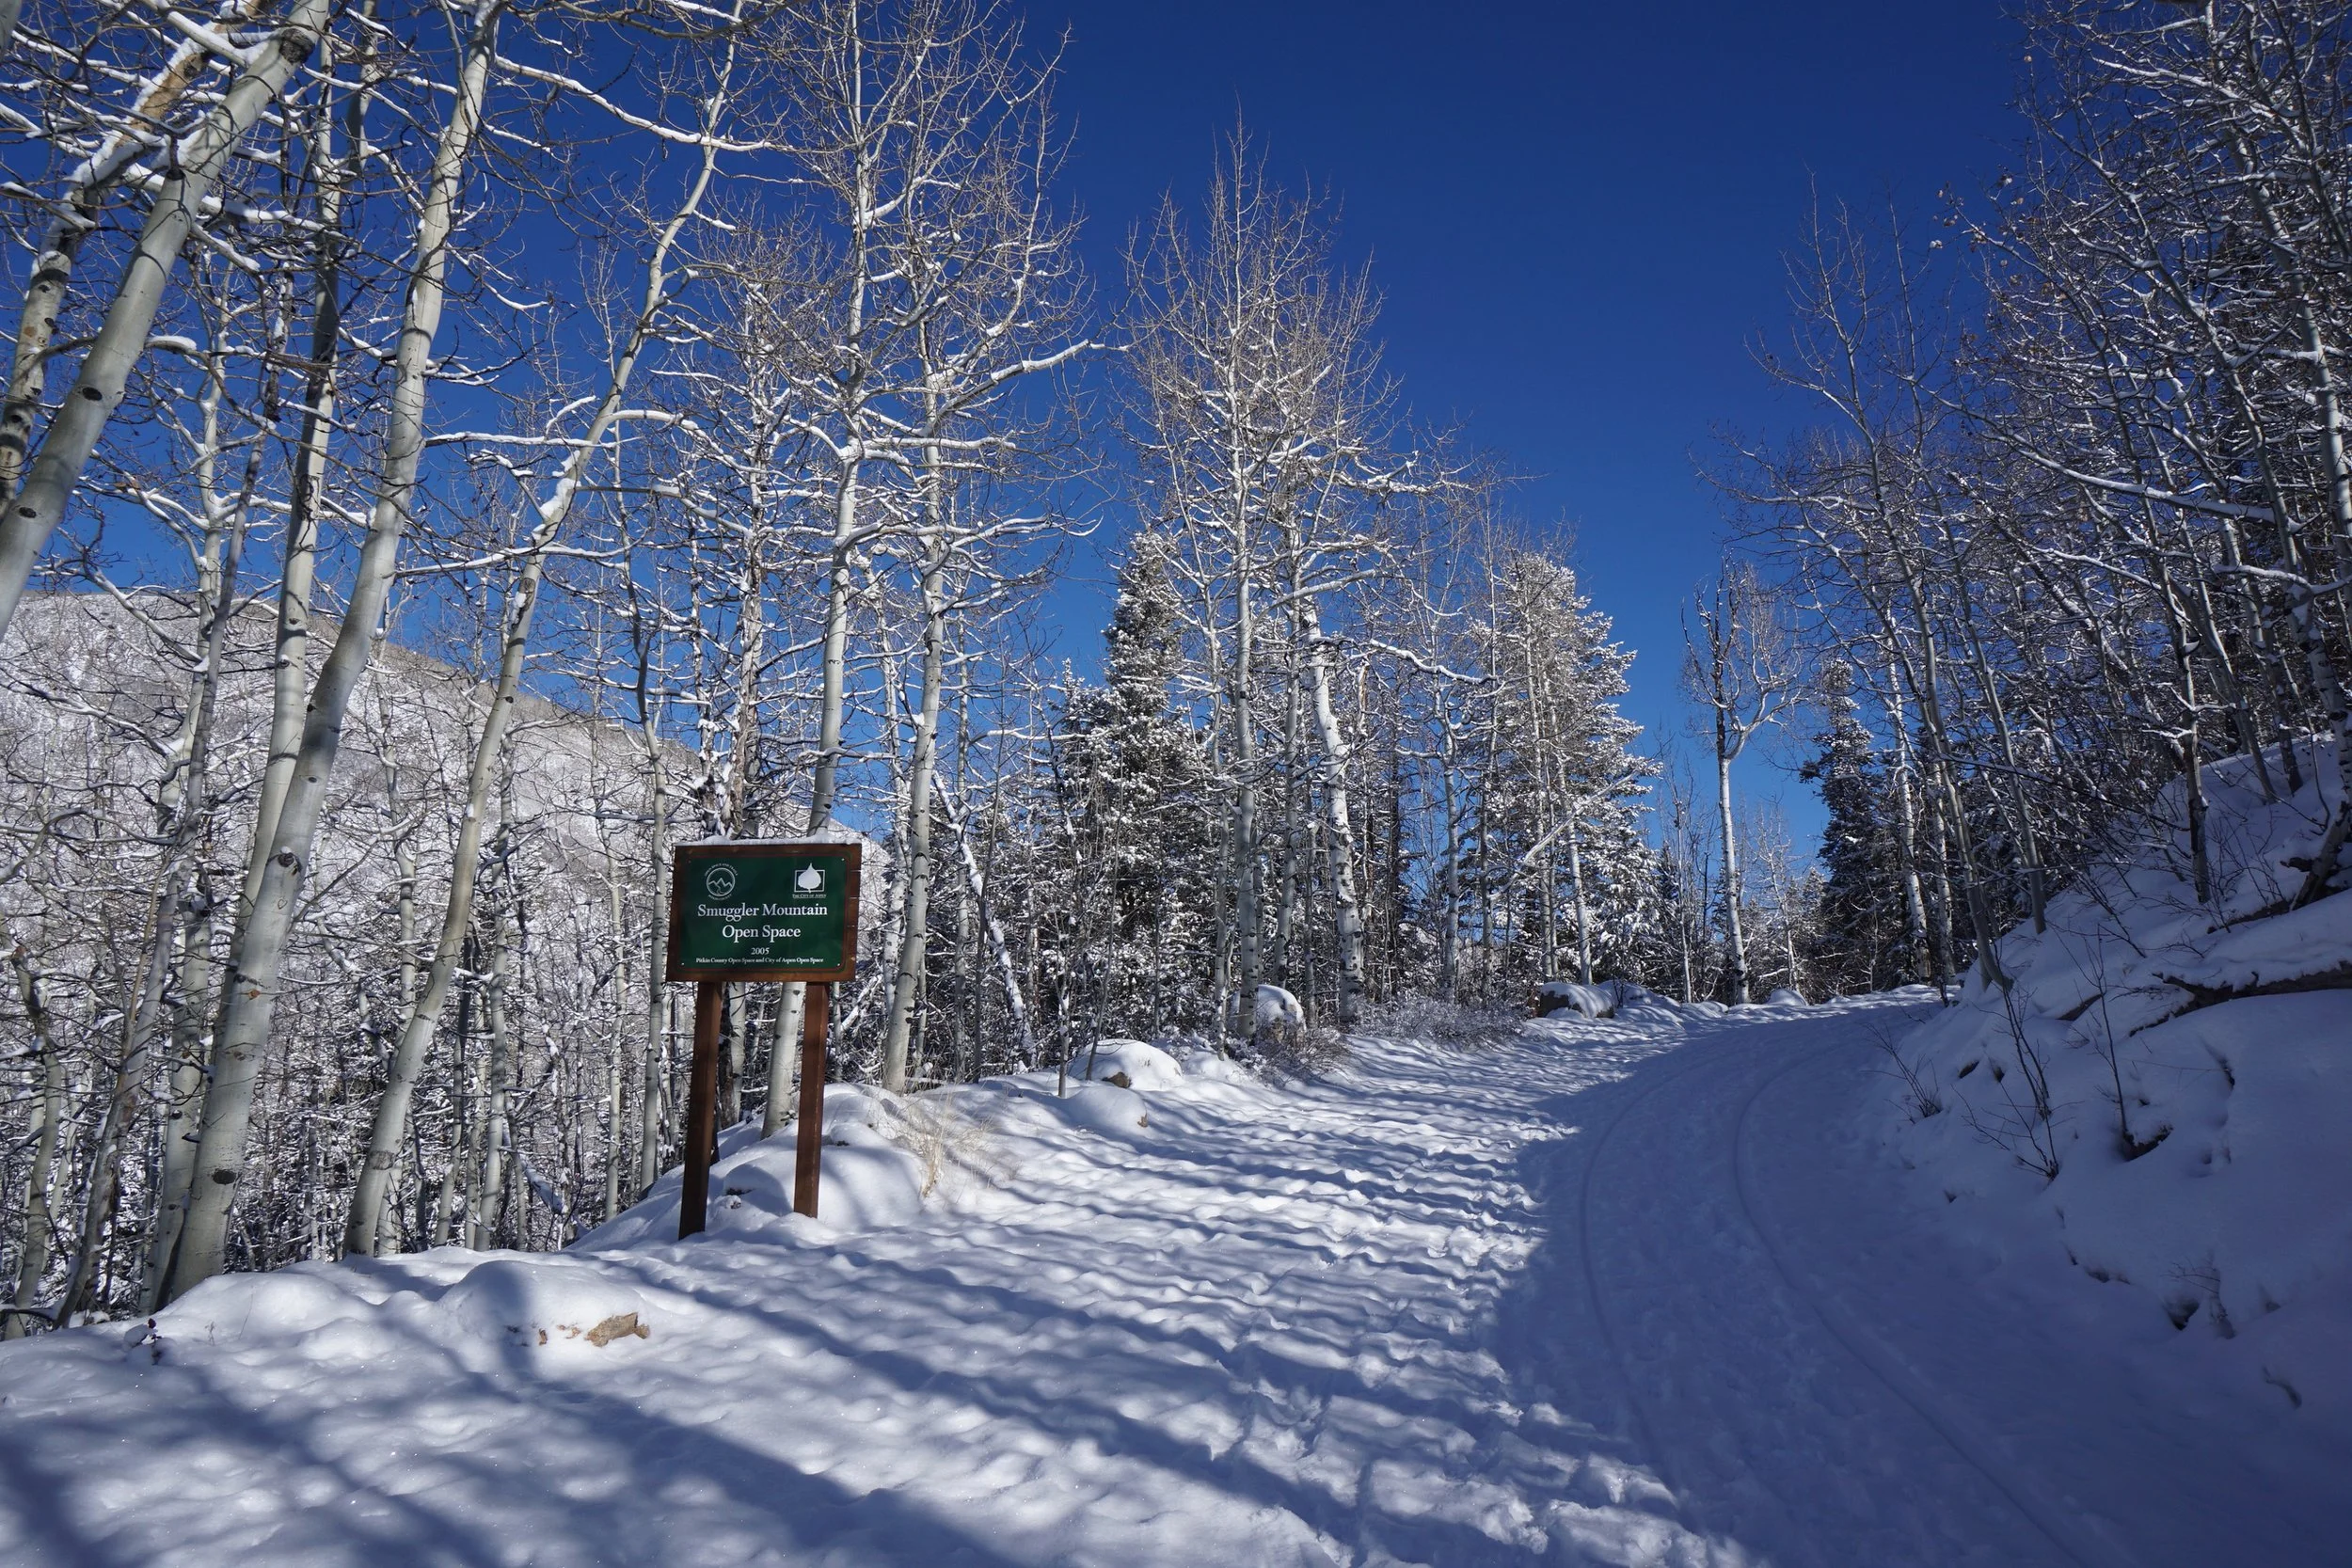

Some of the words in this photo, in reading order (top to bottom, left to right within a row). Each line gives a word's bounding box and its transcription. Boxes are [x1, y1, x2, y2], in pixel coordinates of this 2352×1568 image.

[697, 903, 759, 922] Smuggler
[762, 903, 828, 916] Mountain
[723, 925, 758, 942] Open
[762, 925, 801, 942] Space
[751, 947, 770, 956] 2005
